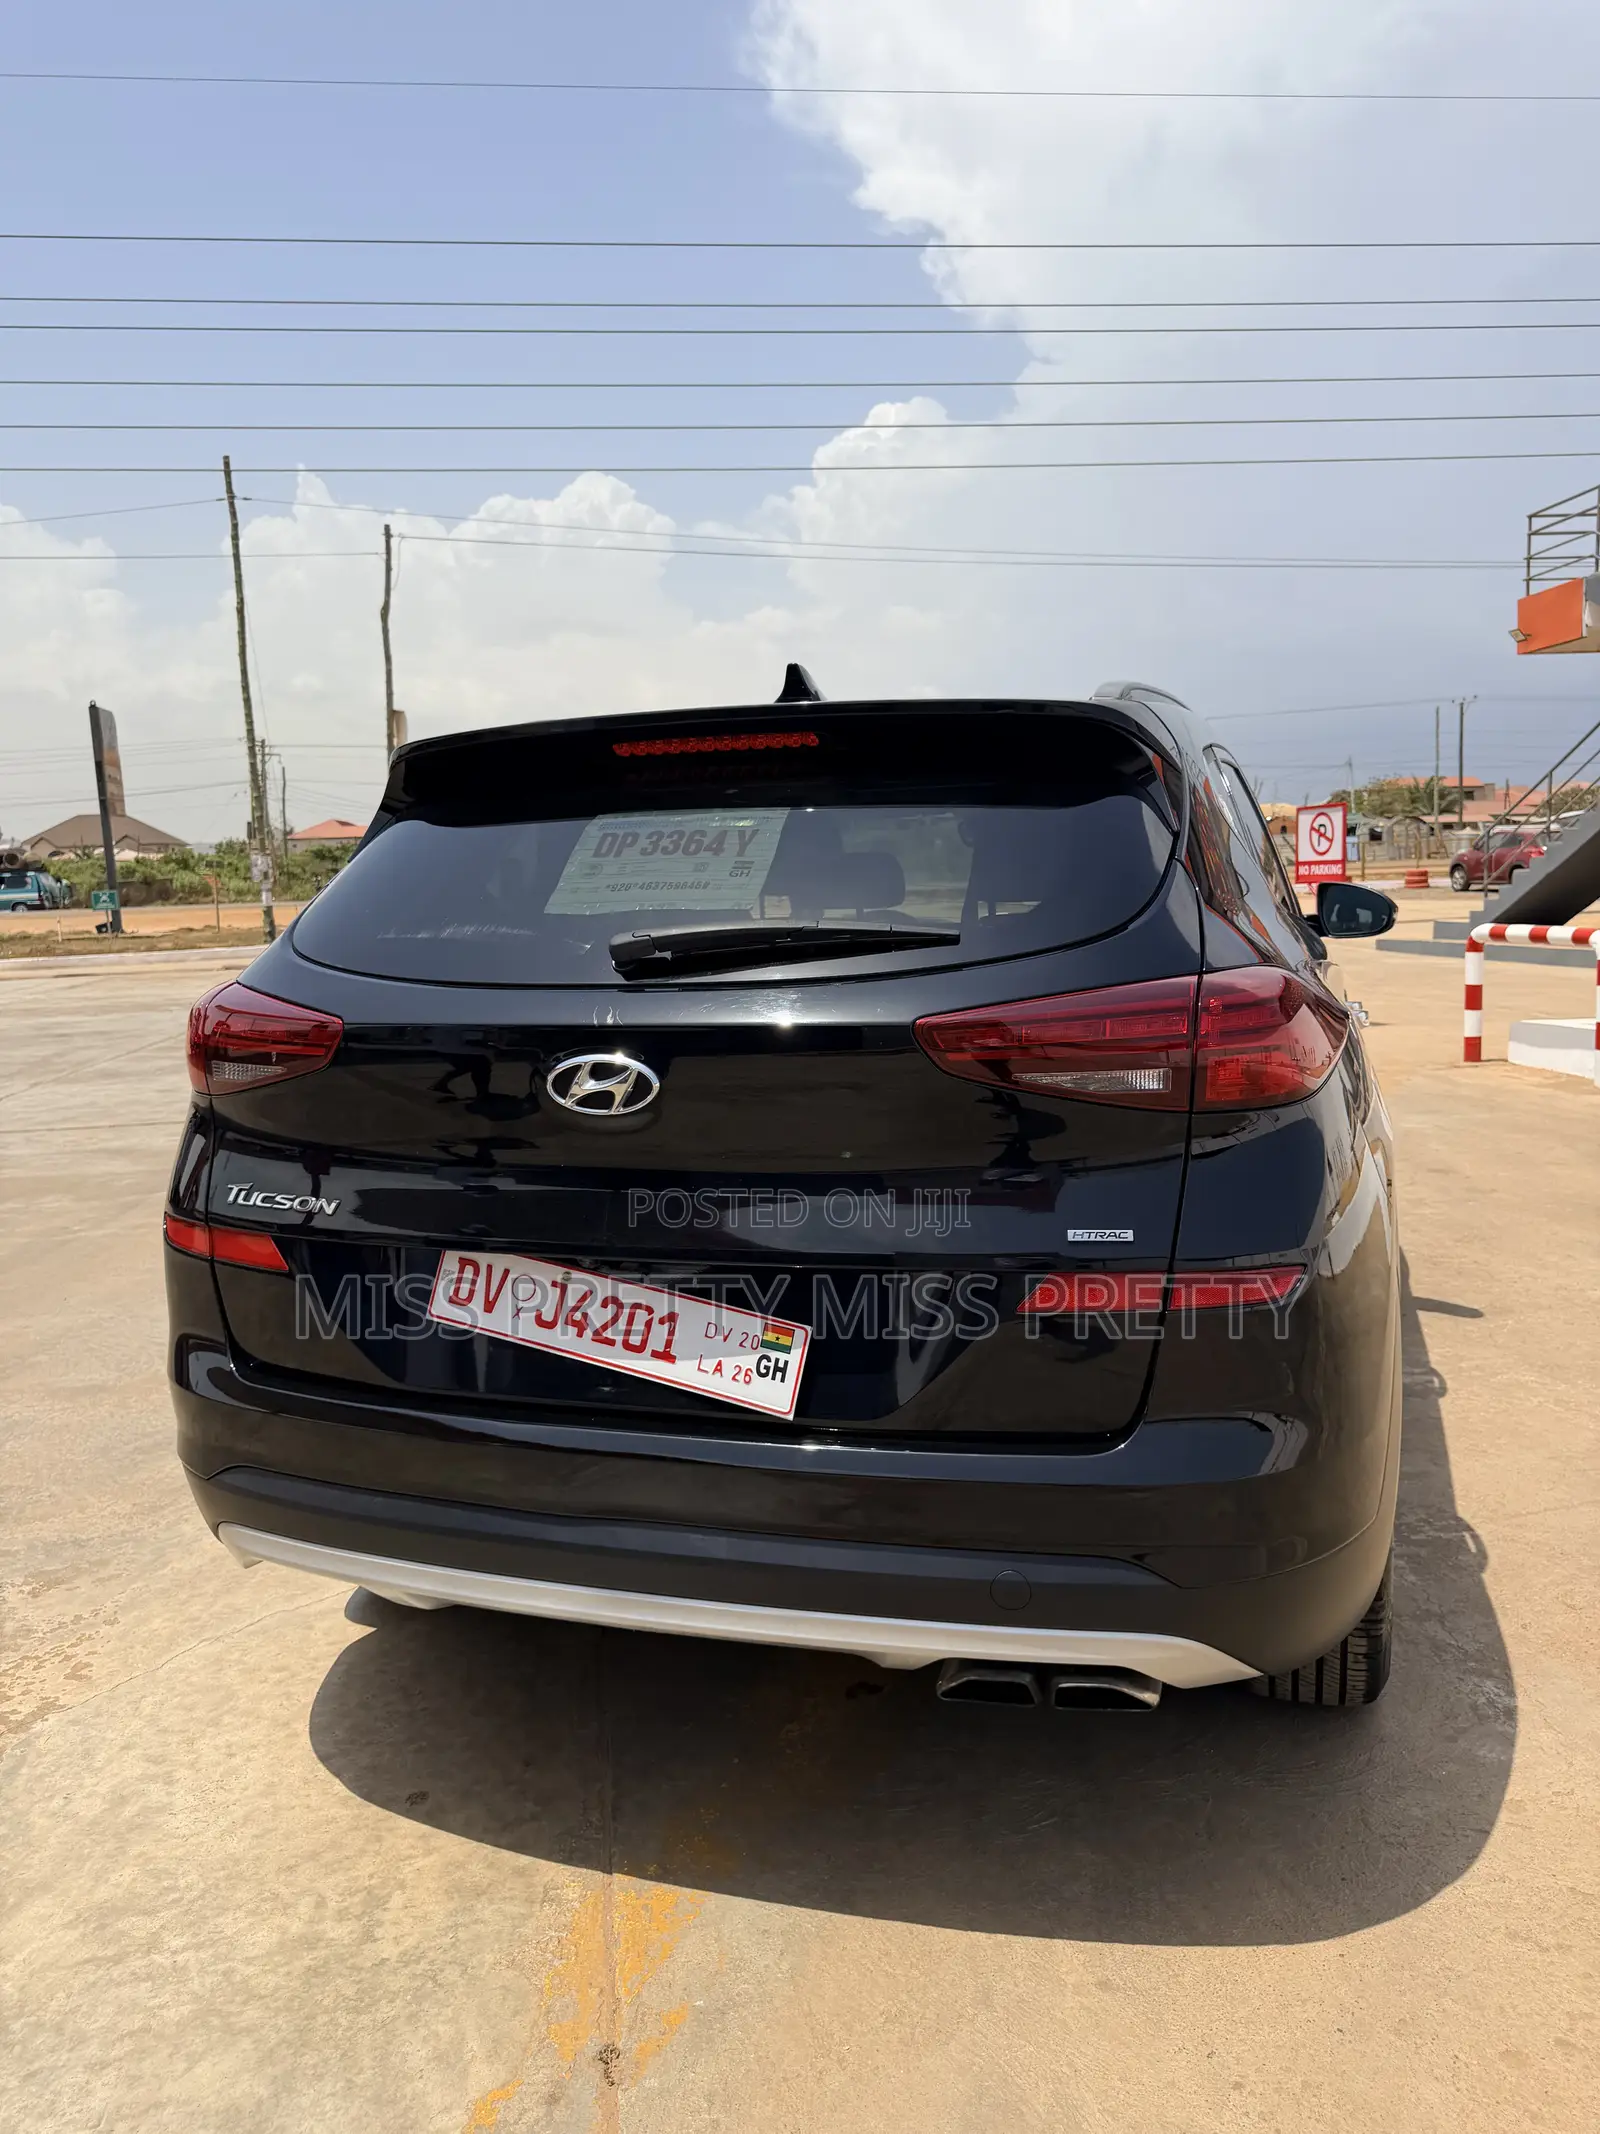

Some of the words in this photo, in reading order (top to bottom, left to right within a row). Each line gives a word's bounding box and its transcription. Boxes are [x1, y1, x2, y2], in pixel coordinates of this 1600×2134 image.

[592, 831, 640, 858] DP
[639, 829, 729, 857] 3364
[736, 829, 760, 857] Y
[729, 869, 751, 878] GH
[1298, 864, 1308, 875] NO
[1310, 863, 1342, 875] PARKING
[1072, 1231, 1129, 1239] HTRAC
[704, 1321, 733, 1343] DV
[738, 1331, 761, 1351] 20
[697, 1354, 724, 1378] LA
[732, 1364, 754, 1385] 26
[756, 1354, 789, 1384] GH
